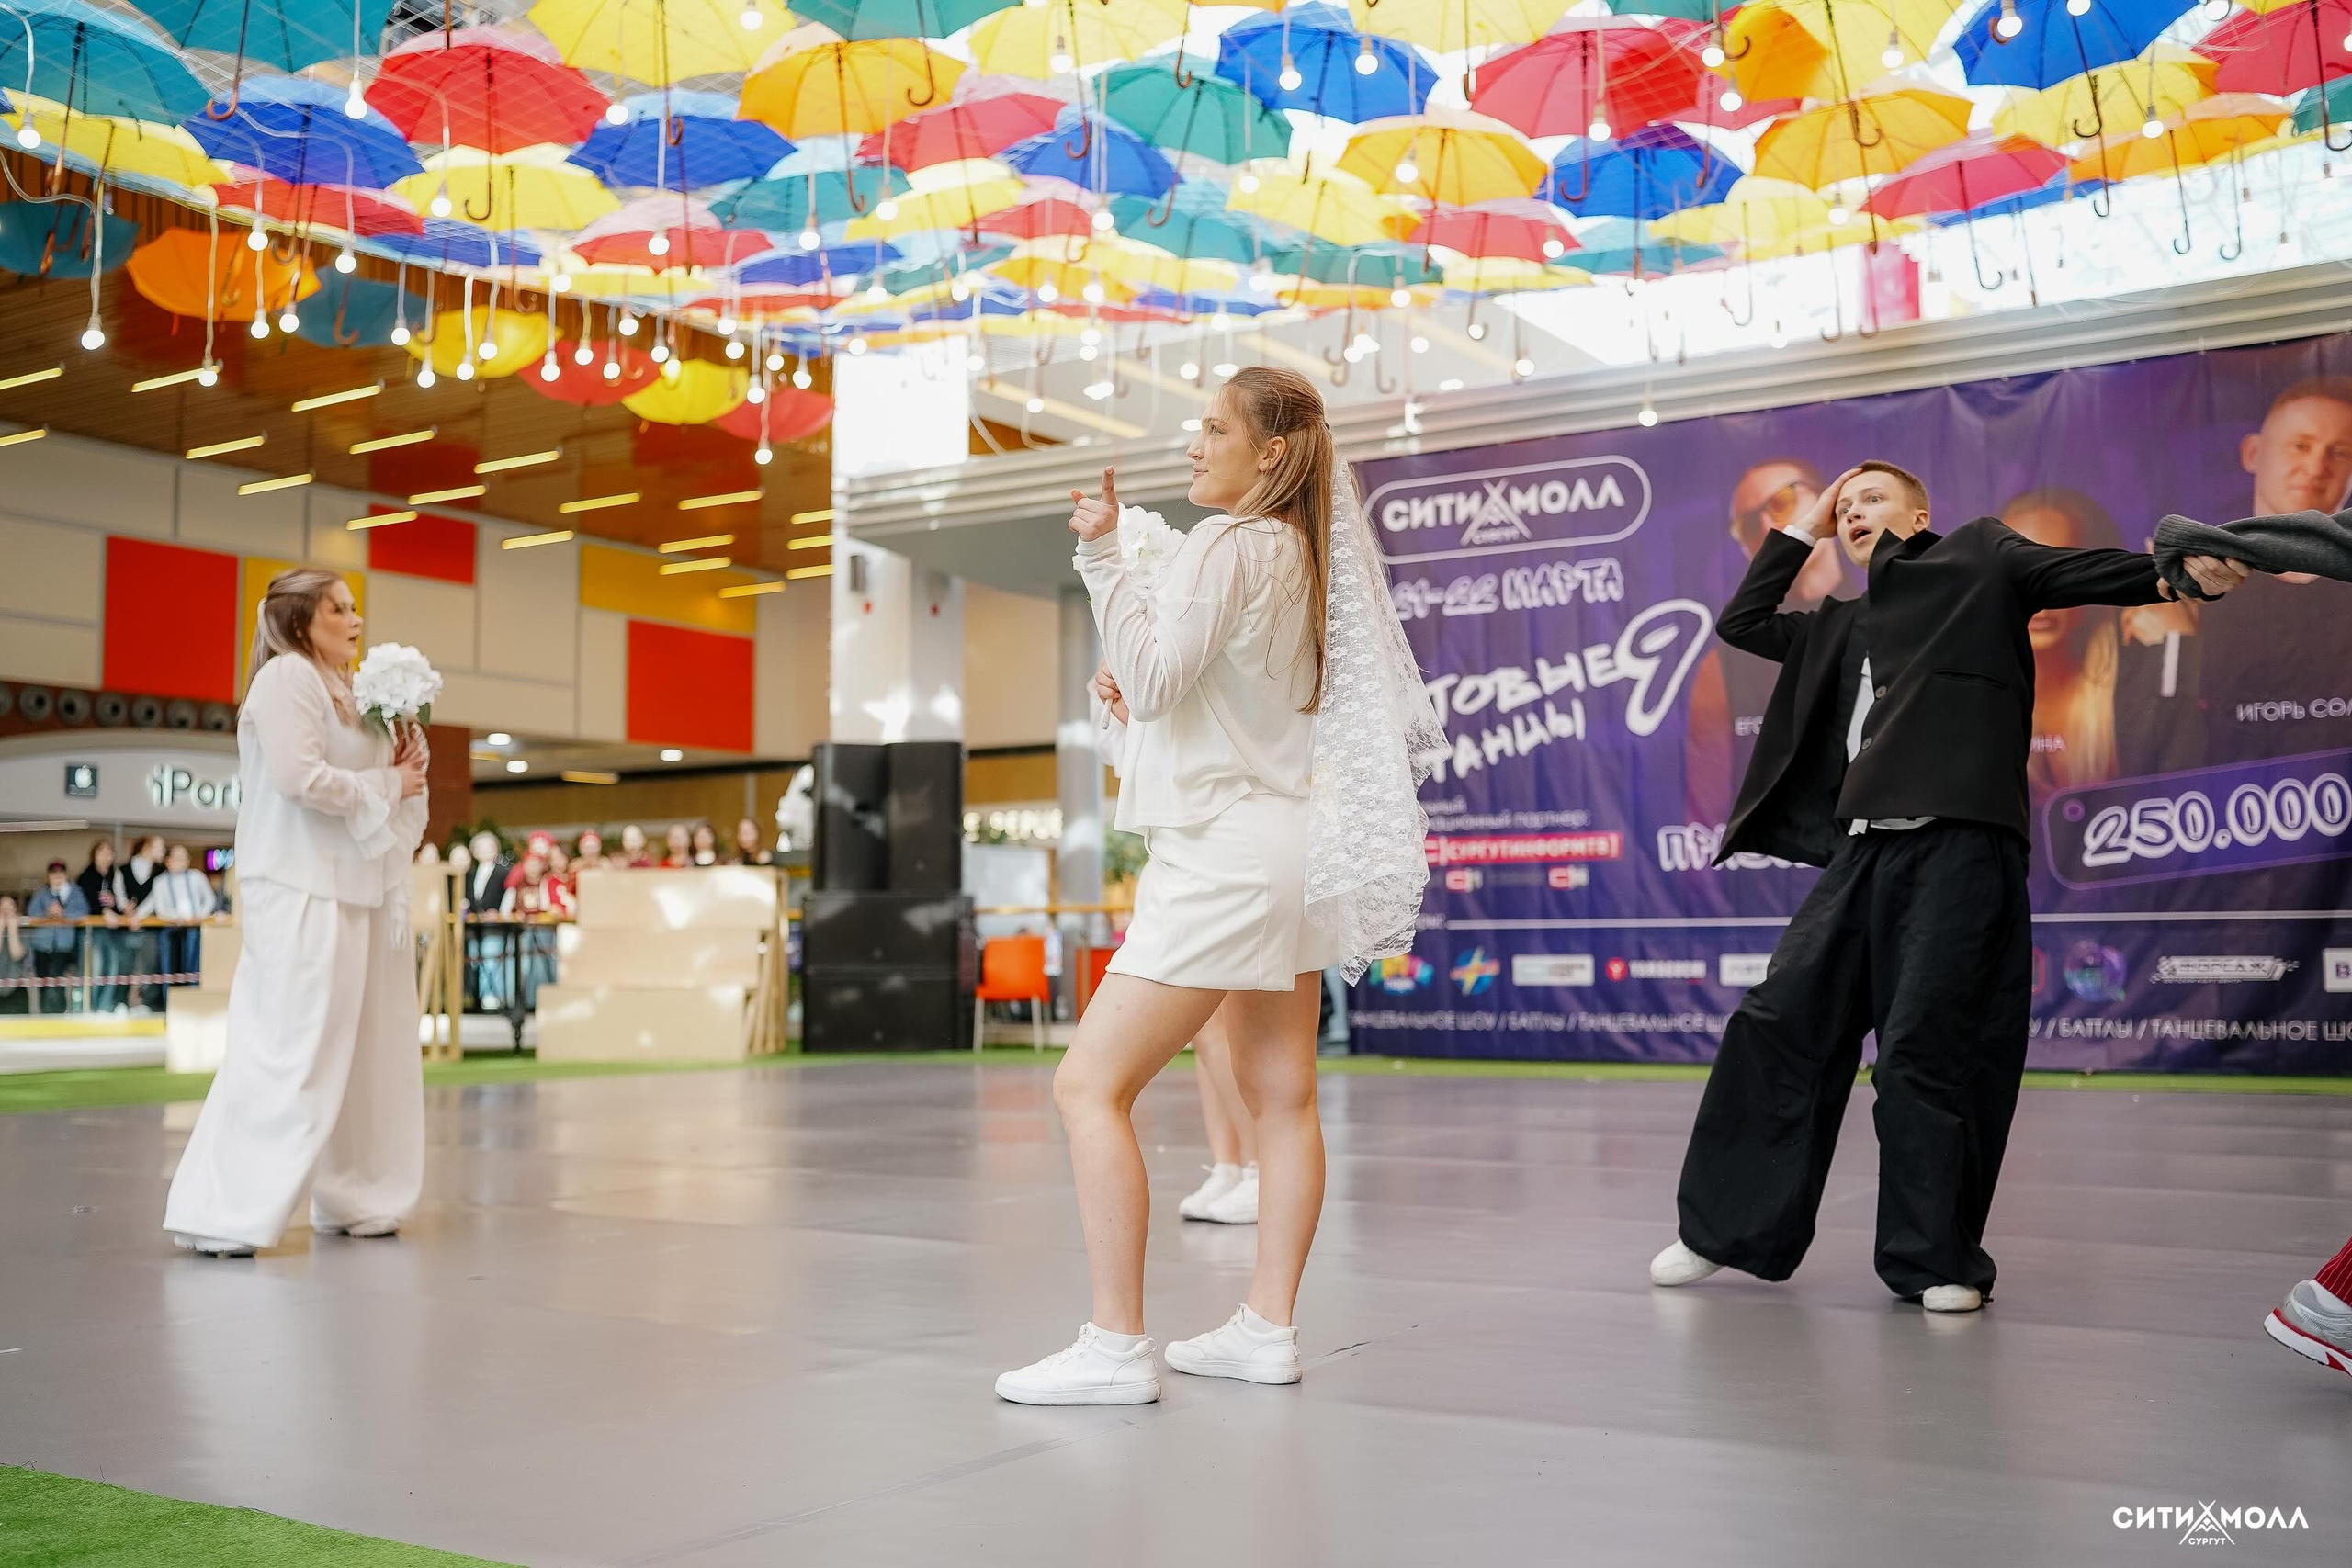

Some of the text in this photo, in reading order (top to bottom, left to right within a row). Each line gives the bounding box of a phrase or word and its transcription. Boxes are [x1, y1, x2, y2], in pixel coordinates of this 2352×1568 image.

[1382, 474, 1625, 532] СИТИ МОЛЛ
[1425, 643, 1614, 728] ТОВЫЕ
[2236, 700, 2305, 722] ИГОРЬ
[2082, 773, 2352, 867] 250.000
[2058, 1018, 2133, 1039] БАТТЛЫ
[2149, 1018, 2318, 1041] ТАНЦЕВАЛЬНОЕ
